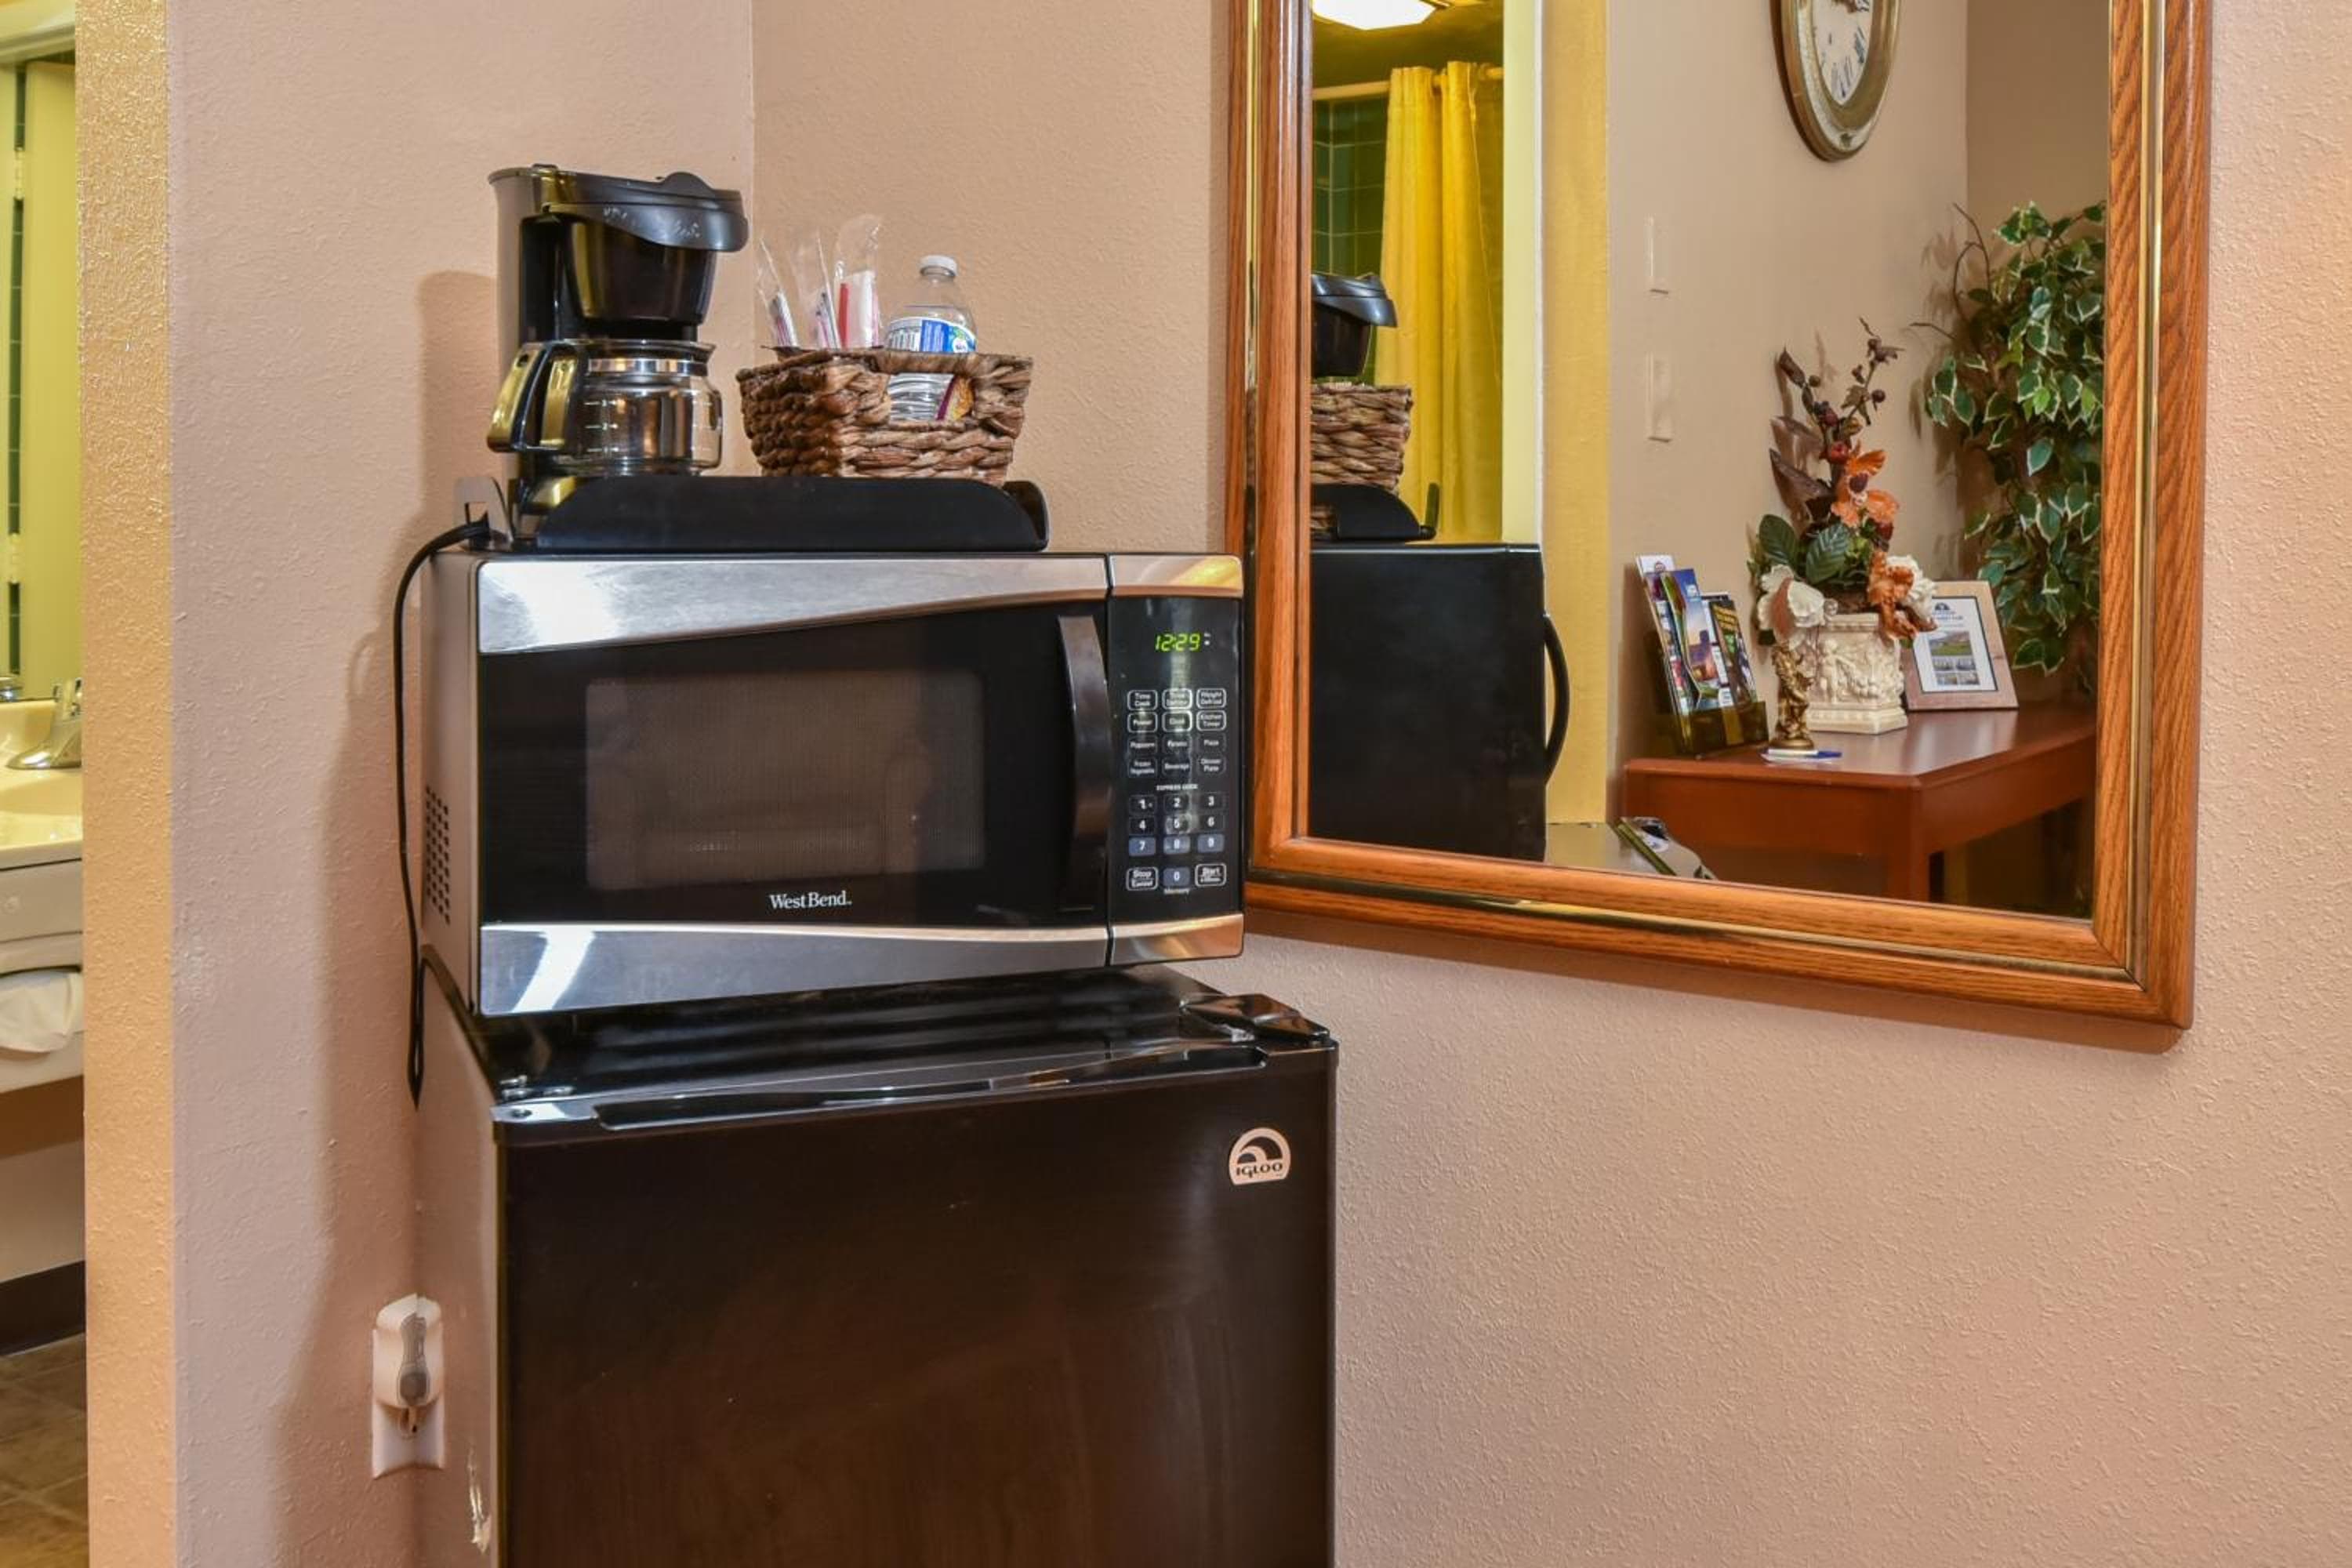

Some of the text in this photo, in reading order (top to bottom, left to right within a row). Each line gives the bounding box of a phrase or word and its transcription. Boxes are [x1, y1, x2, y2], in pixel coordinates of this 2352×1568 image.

[1155, 633, 1201, 652] 12:29
[1139, 799, 1146, 809] 1
[1174, 797, 1181, 808] 2
[1208, 796, 1214, 806] 3
[1139, 820, 1146, 829] 4
[1174, 818, 1180, 828] 5
[1207, 816, 1214, 827] 6
[1139, 840, 1145, 851] 7
[1174, 871, 1180, 881] 0
[769, 891, 847, 909] West Bend
[1236, 1162, 1283, 1178] IGLOO
